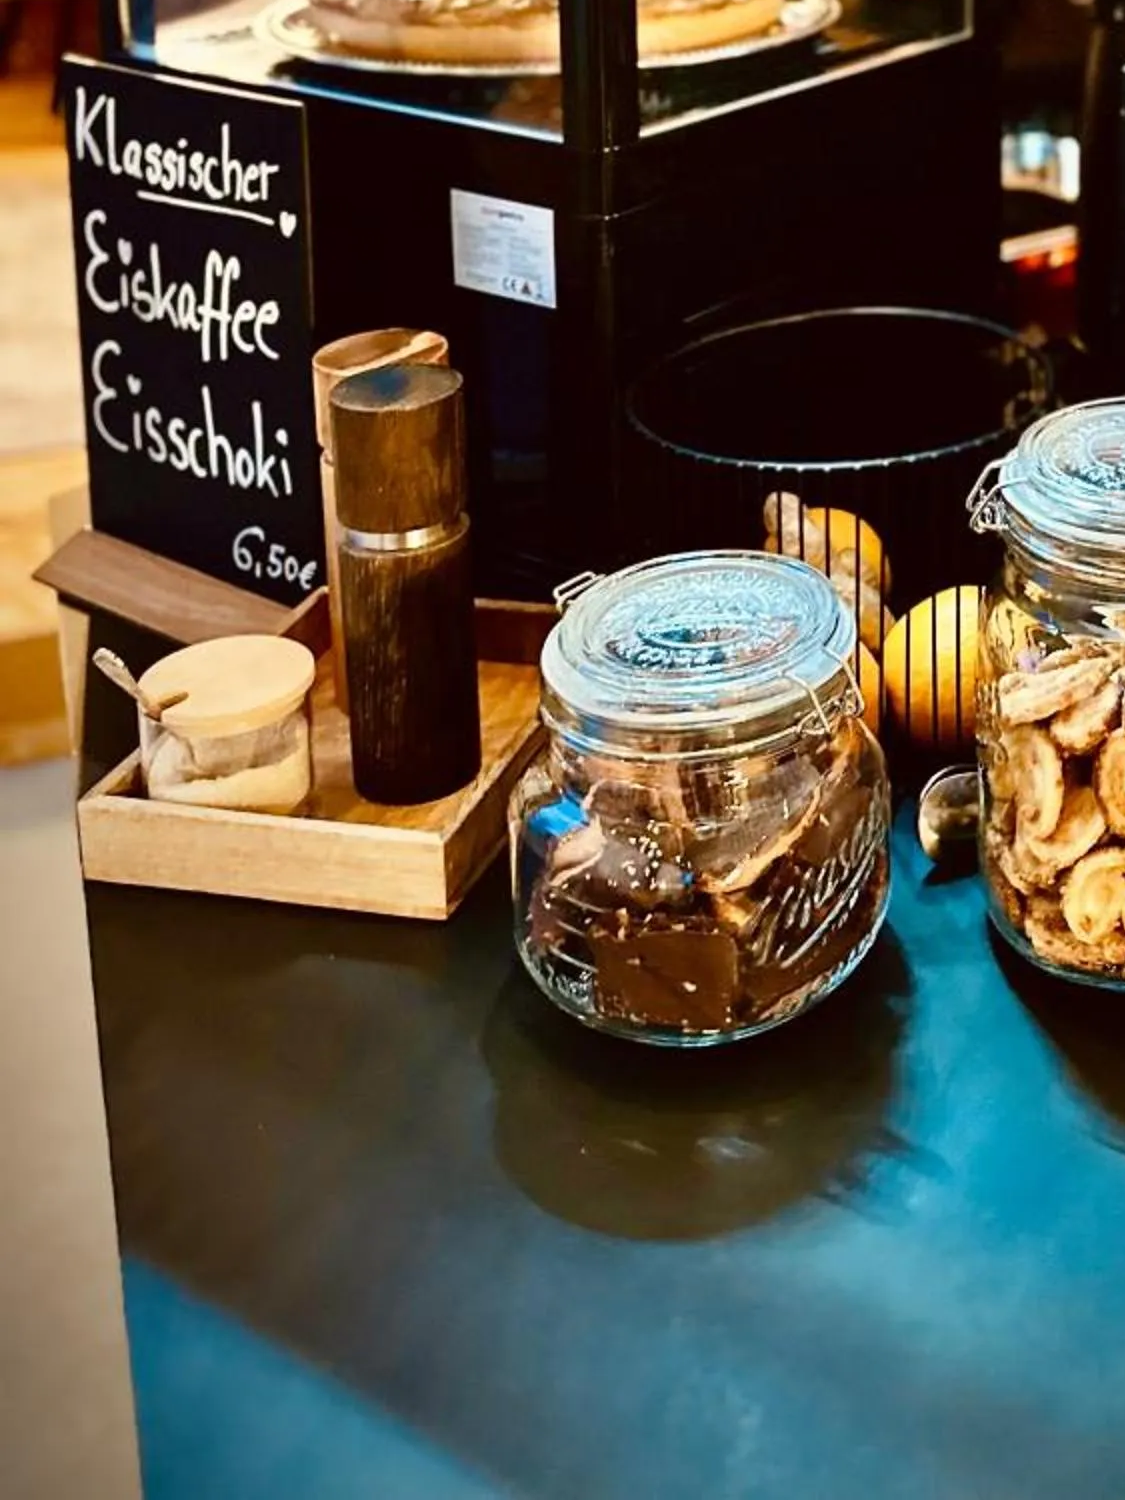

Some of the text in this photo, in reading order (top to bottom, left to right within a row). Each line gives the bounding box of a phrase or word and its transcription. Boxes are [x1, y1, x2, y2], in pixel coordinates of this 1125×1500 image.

[75, 85, 278, 202] Klassischer
[84, 209, 280, 362] Eiskaffee
[92, 339, 293, 498] Eisschoki
[232, 525, 318, 591] 6,50€
